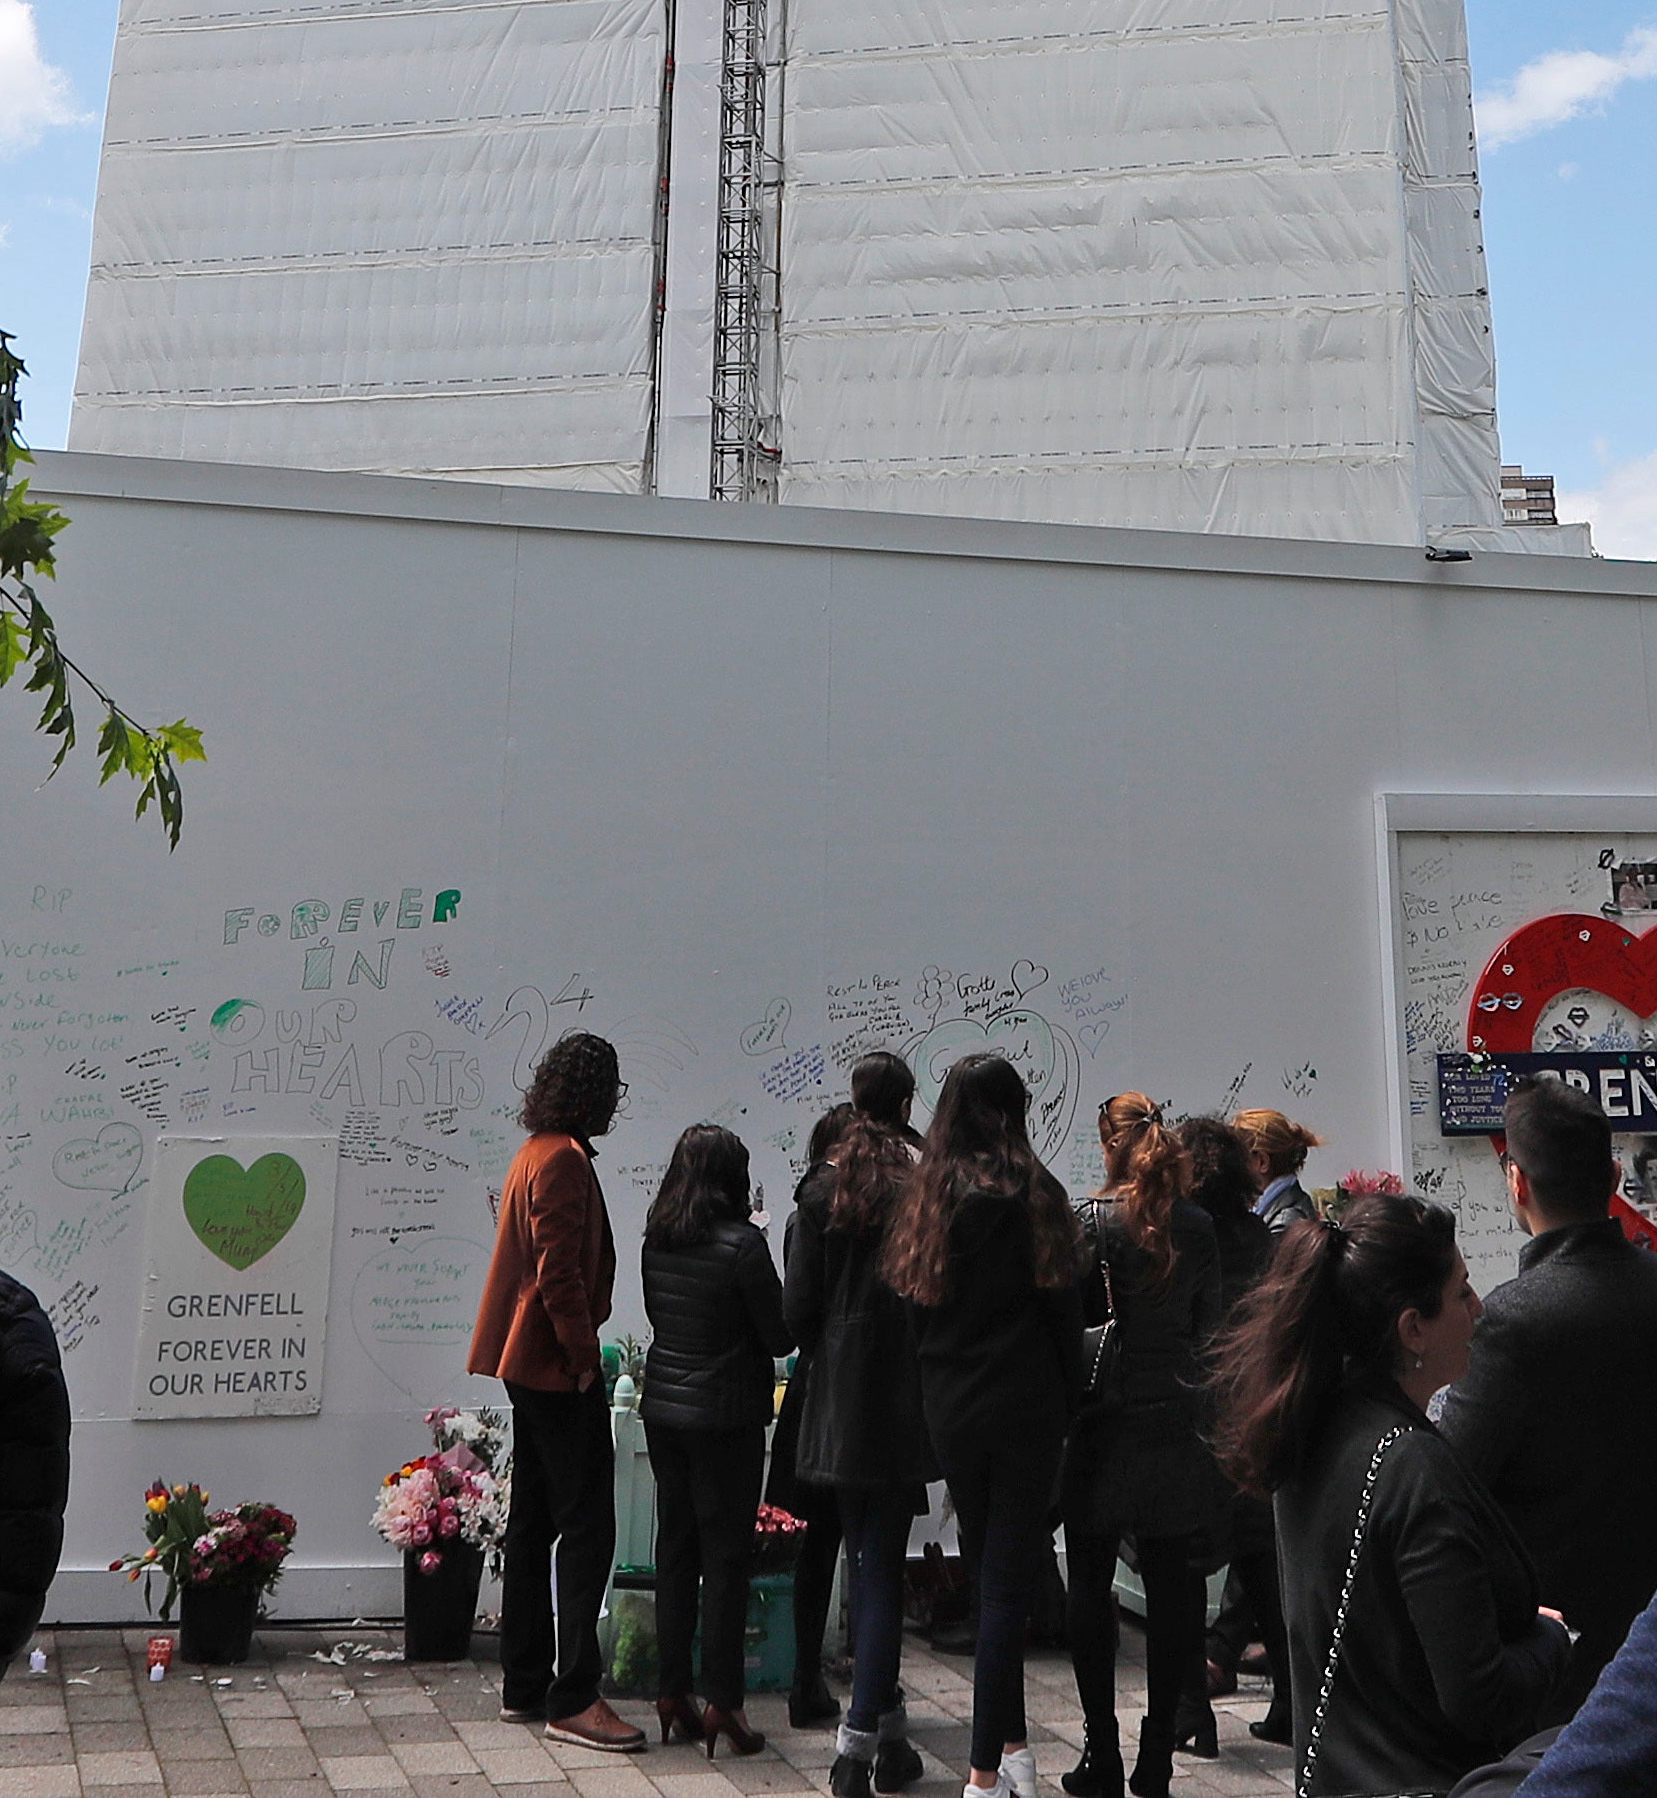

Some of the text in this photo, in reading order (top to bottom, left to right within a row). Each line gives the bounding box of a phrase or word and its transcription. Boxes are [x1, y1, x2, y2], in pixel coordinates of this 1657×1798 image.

[31, 885, 73, 913] RIP
[210, 998, 358, 1046] OUR
[231, 1030, 485, 1110] HEARTS
[167, 1292, 305, 1319] GRENFELL
[158, 1337, 307, 1363] FOREVER IN
[148, 1369, 308, 1397] OUR HEARTS
